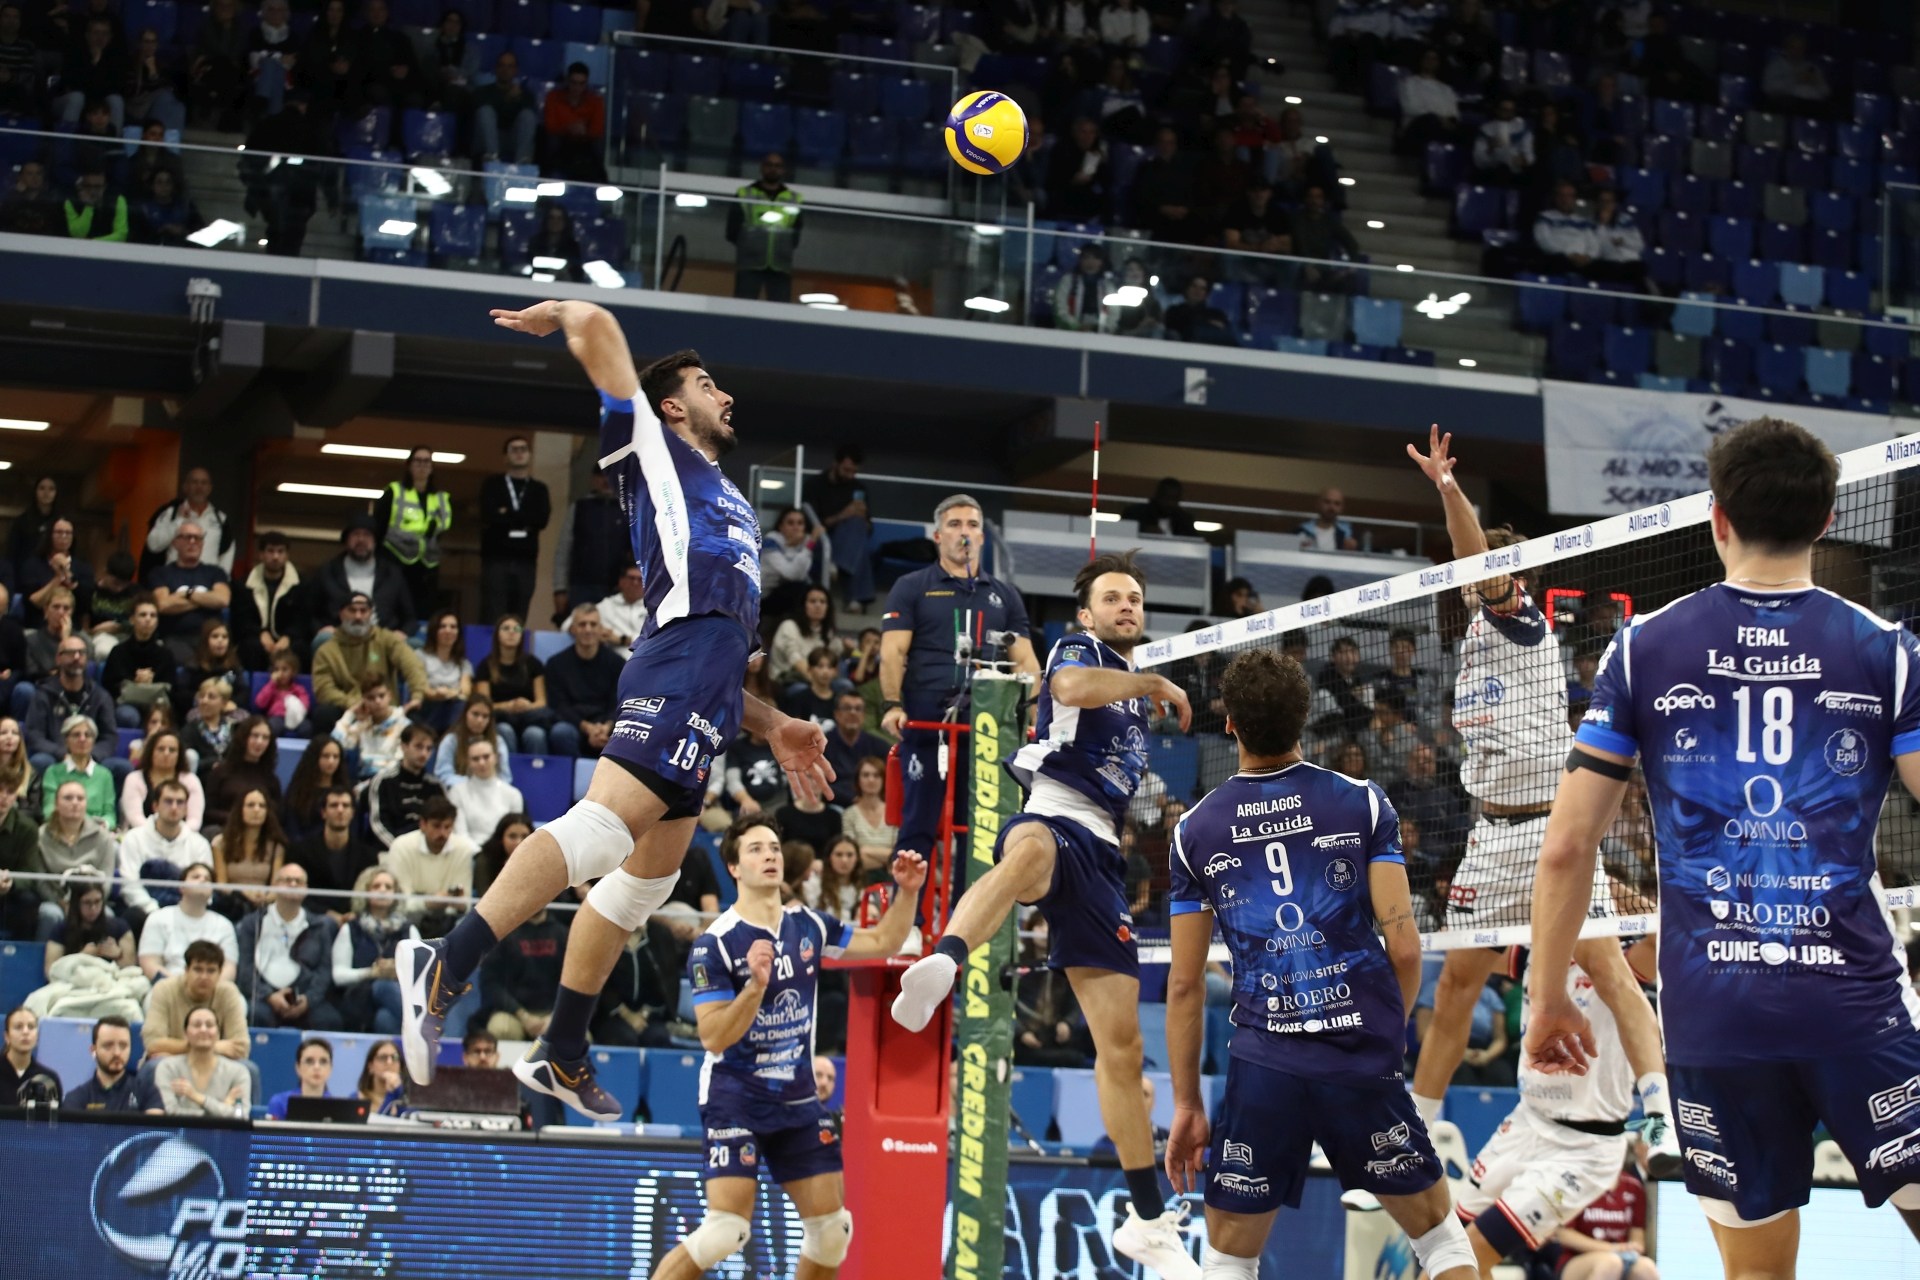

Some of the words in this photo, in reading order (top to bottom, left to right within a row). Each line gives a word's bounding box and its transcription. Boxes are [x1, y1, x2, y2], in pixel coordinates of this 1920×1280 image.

[966, 149, 987, 162] V200W
[1602, 457, 1630, 476] AL
[1640, 458, 1682, 478] MIO
[1688, 459, 1707, 479] SE
[1603, 485, 1705, 506] SCATEN
[1628, 510, 1658, 532] Allianz
[1554, 532, 1581, 552] Allianz
[1484, 552, 1511, 571] Allianz
[1419, 569, 1444, 588] Allianz
[1358, 587, 1381, 604] Allianz
[1300, 603, 1322, 619] Allianz
[1246, 617, 1267, 632] Allianz
[1195, 631, 1215, 646] Allianz
[1737, 625, 1789, 647] FERAL
[1146, 645, 1165, 658] Allianz
[1707, 649, 1736, 670] La
[1744, 653, 1822, 674] Guida
[1654, 694, 1716, 716] opera
[1825, 697, 1882, 715] GUNETTO
[1732, 685, 1794, 765] 18
[668, 738, 699, 771] 19
[1836, 749, 1858, 766] Epli
[973, 711, 999, 867] CREDEM
[1236, 795, 1302, 817] ARGILAGOS
[1230, 825, 1252, 839] La
[1258, 814, 1313, 834] Guida
[1319, 838, 1361, 849] GUNETTO
[1204, 858, 1242, 878] opera
[1265, 841, 1294, 897] 9
[1333, 871, 1351, 883] Epli
[1733, 902, 1831, 928] ROERO
[774, 955, 794, 980] 20
[965, 942, 990, 1018] NCA
[1282, 983, 1351, 1011] ROERO
[1322, 1000, 1353, 1011] TERRITORIO
[750, 1031, 766, 1041] De
[959, 1043, 987, 1198] CREDEM
[708, 1146, 730, 1169] 20
[895, 1140, 938, 1154] Senoh
[1880, 1141, 1920, 1168] GUNE
[1221, 1177, 1269, 1193] GUNETTO
[955, 1211, 980, 1280] BA
